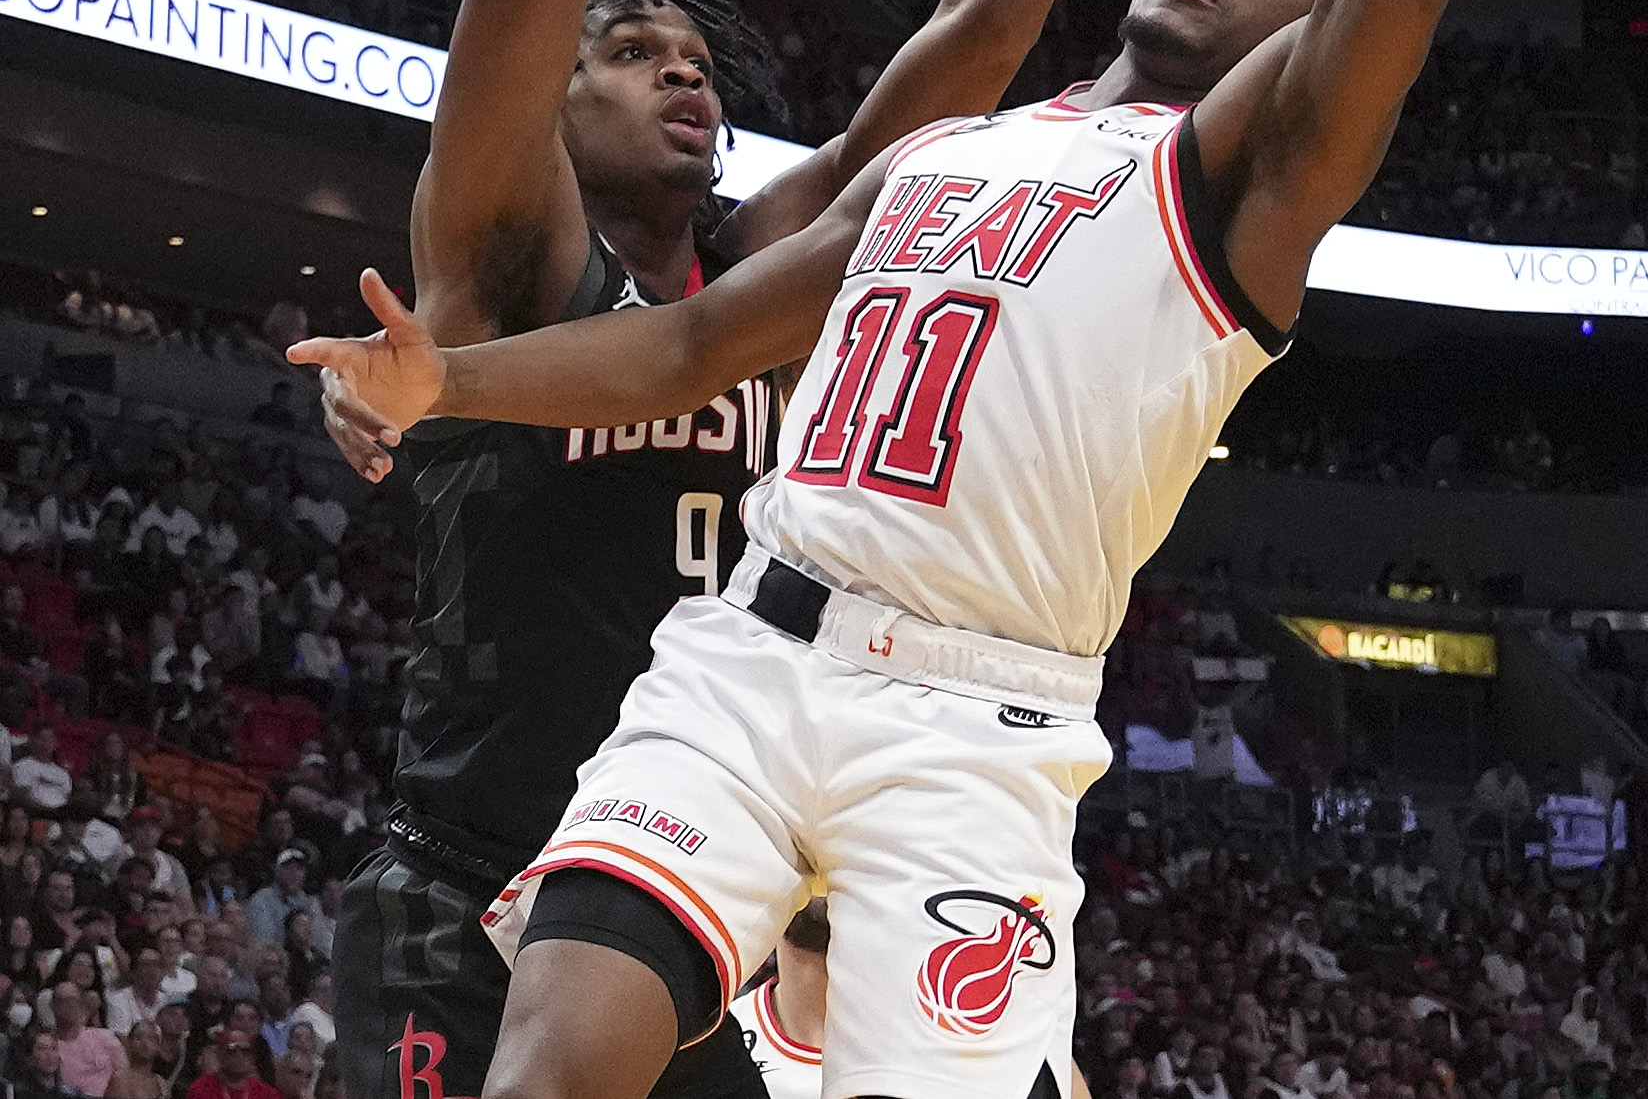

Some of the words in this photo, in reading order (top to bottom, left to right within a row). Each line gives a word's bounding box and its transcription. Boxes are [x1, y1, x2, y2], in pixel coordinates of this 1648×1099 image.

[841, 157, 1138, 289] HEAT
[1505, 252, 1597, 285] VICO
[784, 286, 1001, 509] 11
[675, 492, 724, 600] 9
[563, 798, 708, 856] MIAMI
